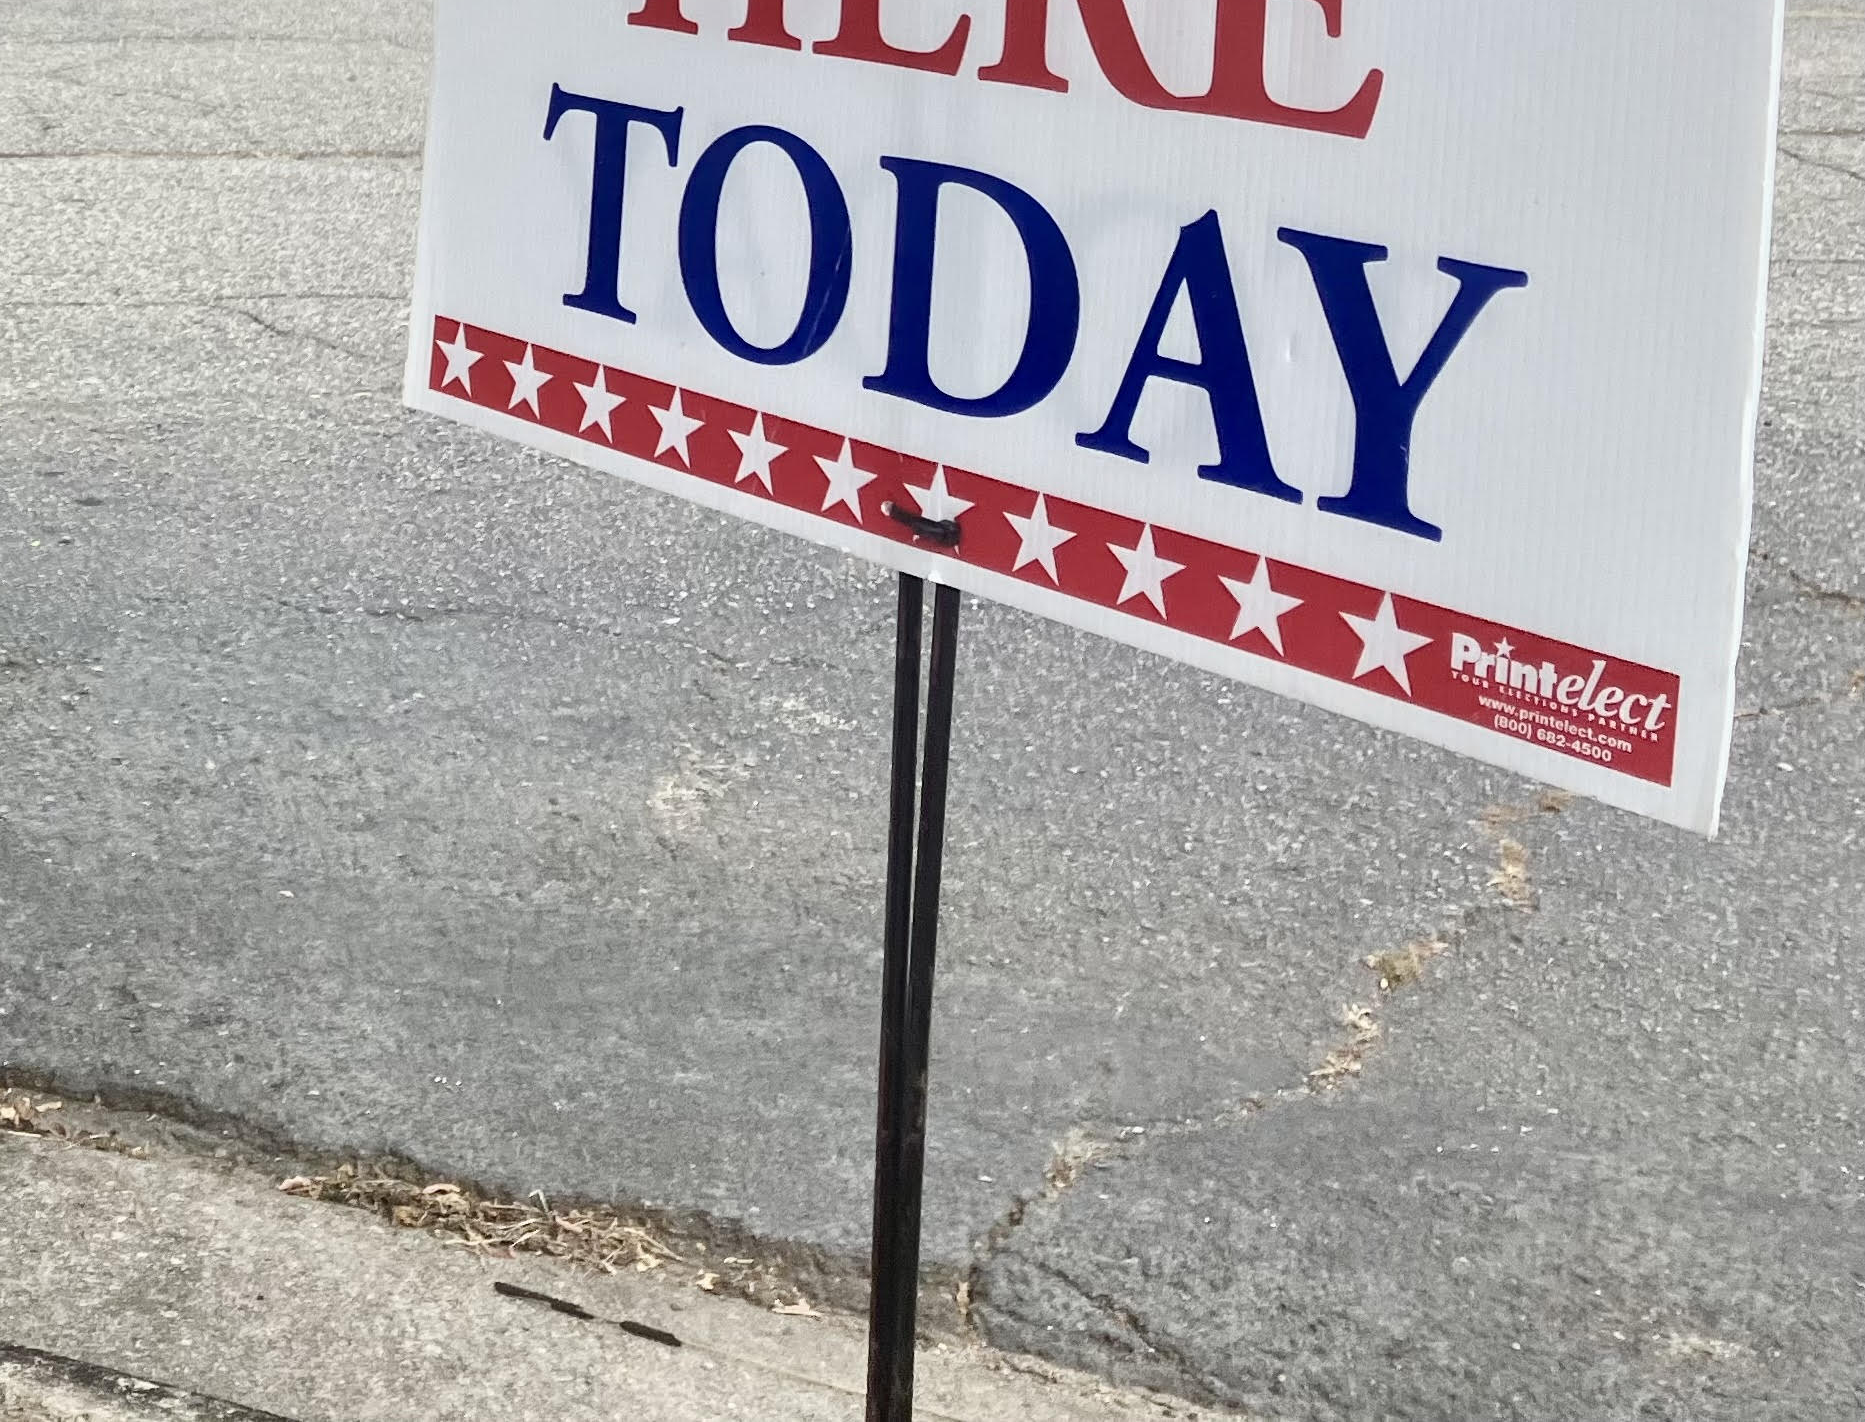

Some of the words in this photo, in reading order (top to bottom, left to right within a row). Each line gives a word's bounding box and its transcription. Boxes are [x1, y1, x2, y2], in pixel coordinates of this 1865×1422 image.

[542, 82, 1529, 543] TODAY
[1450, 631, 1672, 731] Printelect
[1478, 694, 1633, 754] www.printelect.com
[1493, 713, 1533, 740] (800)
[1536, 728, 1613, 763] 682-4500
[1587, 713, 1659, 742] PARTNER
